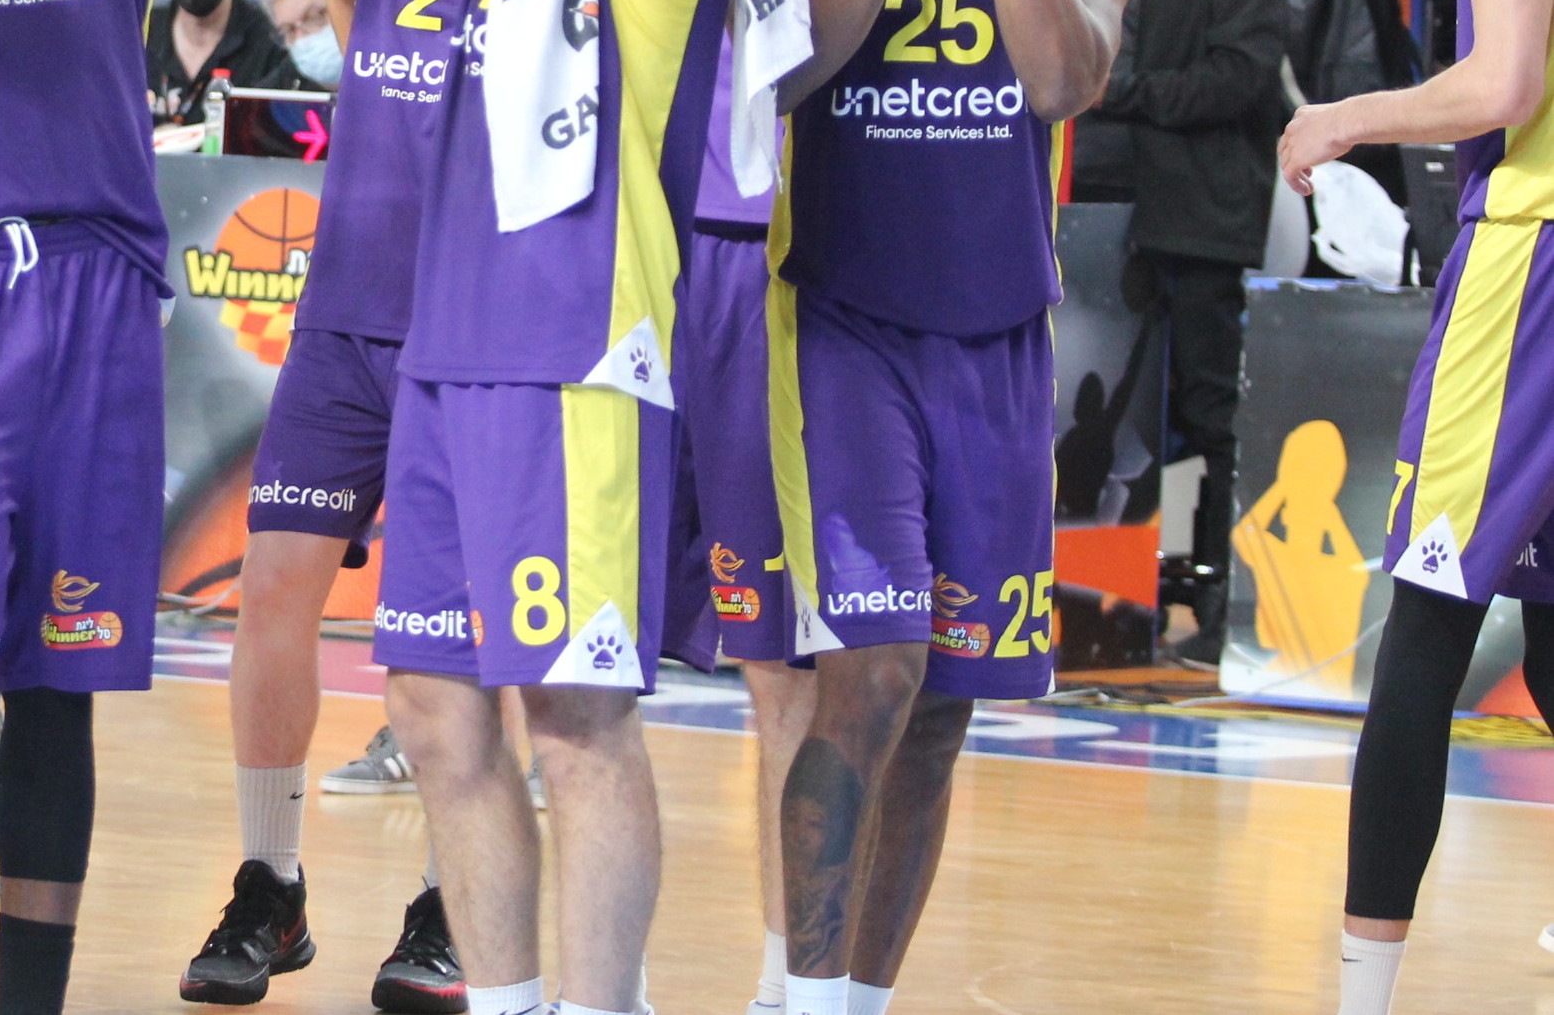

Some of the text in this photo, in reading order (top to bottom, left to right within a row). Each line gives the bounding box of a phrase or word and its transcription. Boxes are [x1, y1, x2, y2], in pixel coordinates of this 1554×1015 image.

[541, 84, 599, 150] GA
[831, 78, 1029, 117] unetcred
[865, 123, 1014, 140] Finance Services Ltd.
[511, 555, 567, 647] 8
[993, 569, 1054, 659] 25
